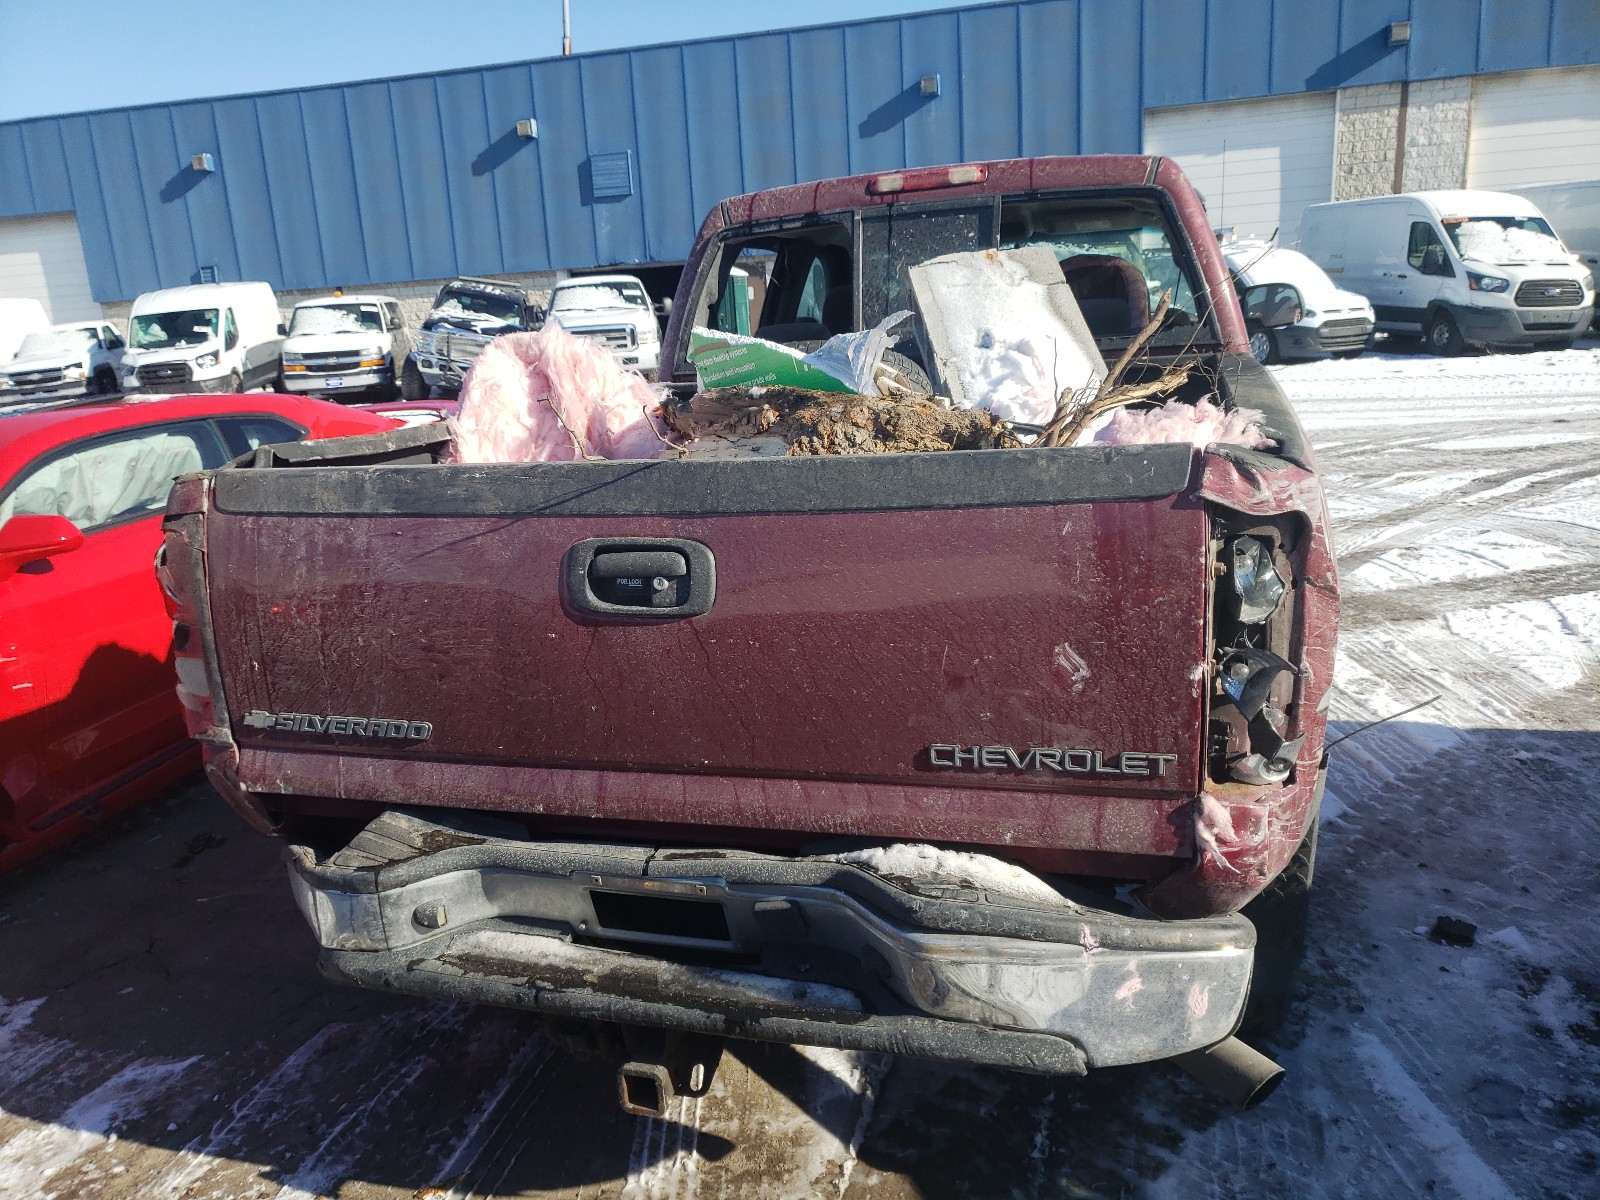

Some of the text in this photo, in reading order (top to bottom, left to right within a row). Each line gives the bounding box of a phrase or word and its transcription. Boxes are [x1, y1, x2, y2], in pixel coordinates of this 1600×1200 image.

[730, 347, 748, 359] systems
[275, 712, 433, 740] SILVERADO
[929, 743, 1178, 776] CHEVROLET
